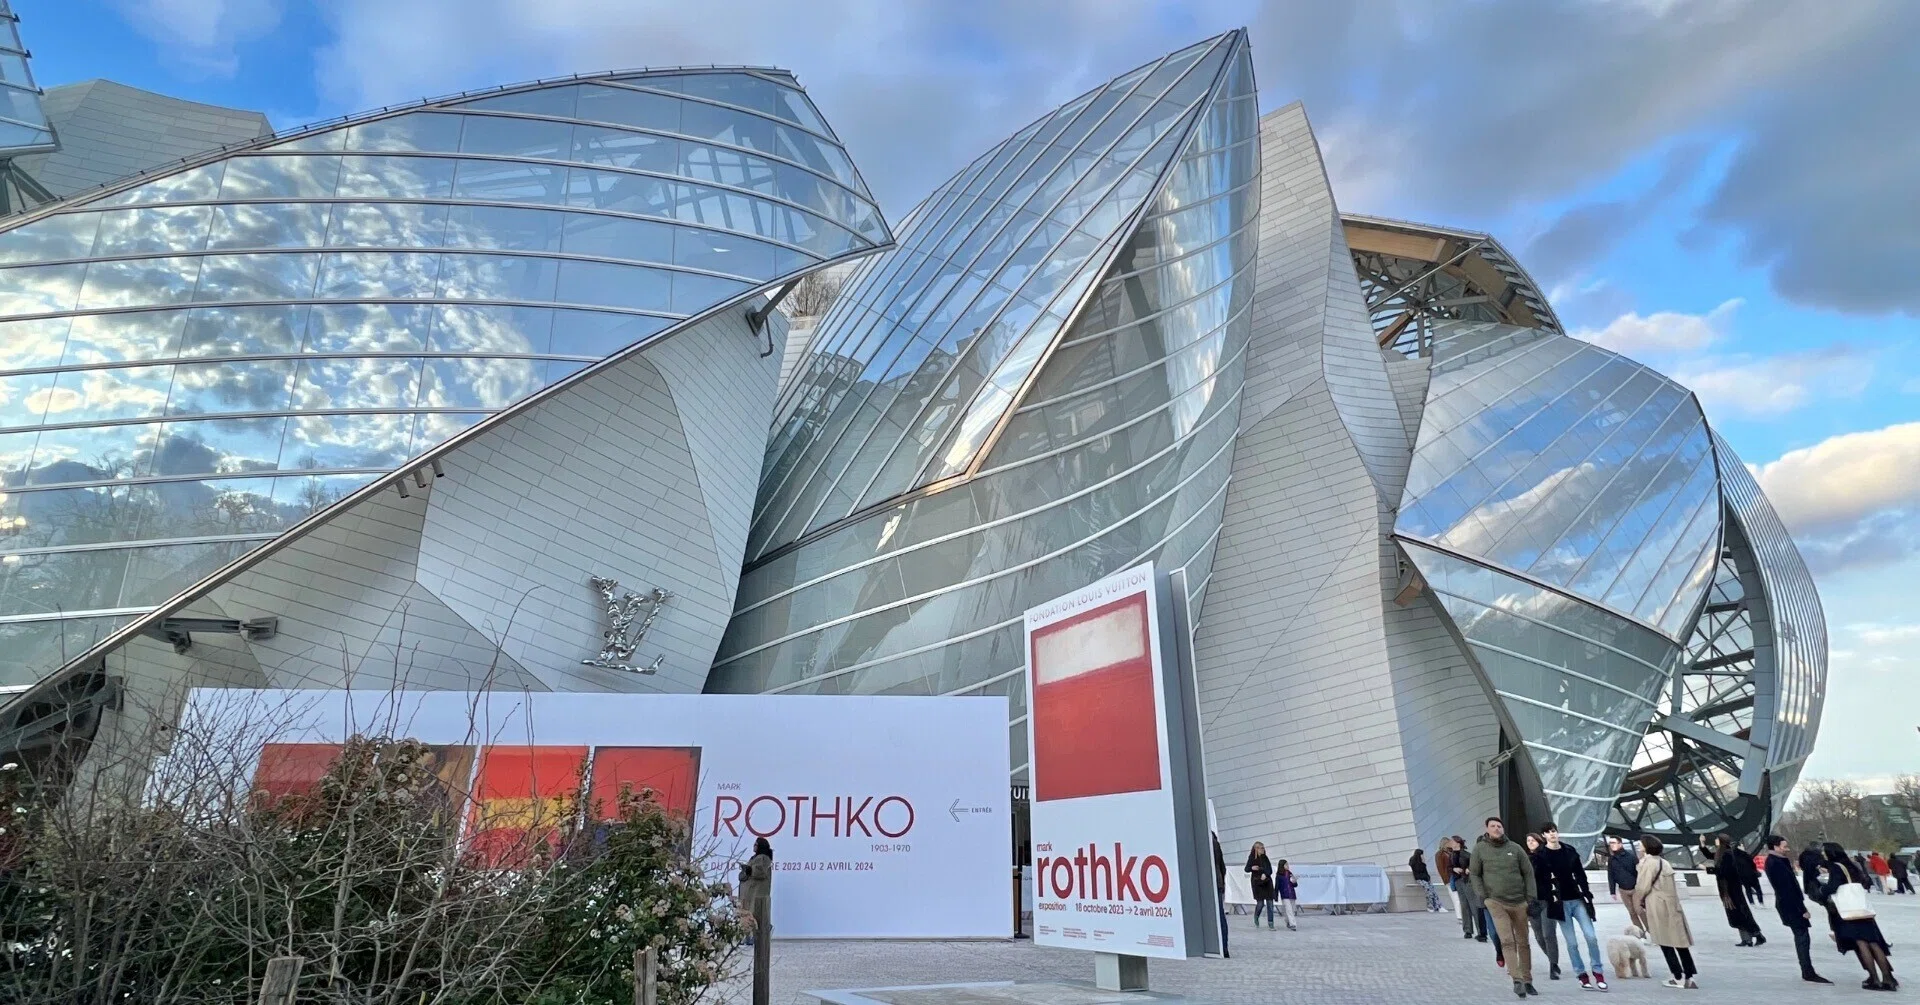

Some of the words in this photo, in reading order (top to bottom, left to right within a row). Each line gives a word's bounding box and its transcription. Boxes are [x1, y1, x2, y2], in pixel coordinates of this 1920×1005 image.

[1029, 600, 1075, 624] FONDATION
[1077, 590, 1103, 606] LOUIS
[1105, 572, 1146, 594] VUITTON
[713, 796, 915, 838] ROTHKO
[1037, 842, 1052, 851] mark
[782, 862, 801, 870] 2023
[804, 862, 816, 870] AU
[819, 862, 824, 870] 2
[827, 862, 852, 870] AVRIL
[855, 862, 874, 870] 2024
[1037, 842, 1169, 903] rothko
[1038, 902, 1066, 912] exposition
[1075, 902, 1082, 912] 18
[1083, 904, 1108, 914] octobre
[1108, 904, 1124, 915] 2023
[1139, 907, 1154, 917] avril
[1155, 907, 1172, 918] 2024
